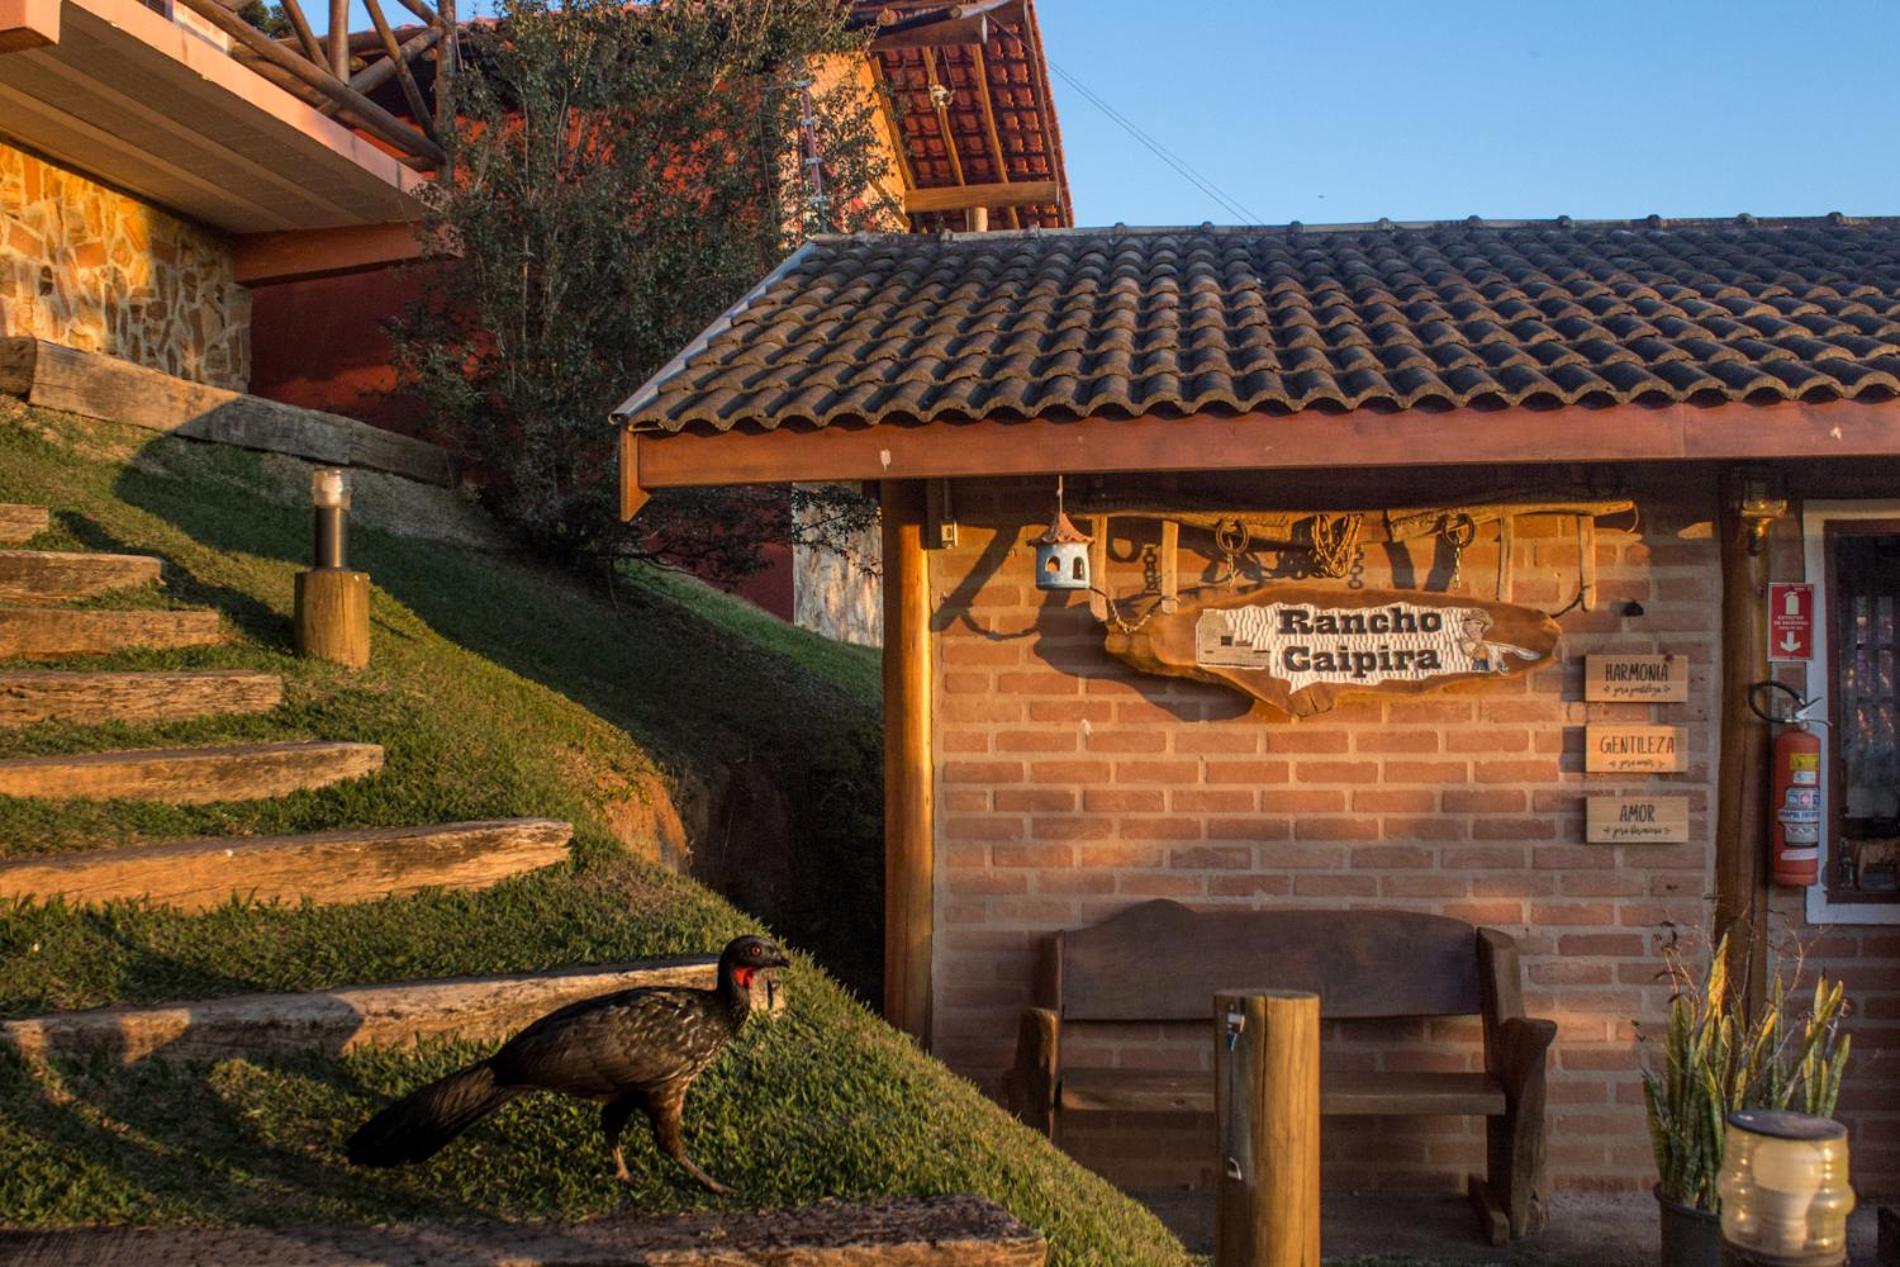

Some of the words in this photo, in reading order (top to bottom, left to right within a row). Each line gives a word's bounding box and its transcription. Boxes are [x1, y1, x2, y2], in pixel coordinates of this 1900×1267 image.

[1278, 607, 1442, 635] Rancho
[1284, 645, 1442, 678] Caipira
[1605, 663, 1669, 681] HARMONIA
[1600, 735, 1675, 754] GENTILEZA
[1619, 804, 1656, 822] AMOR
